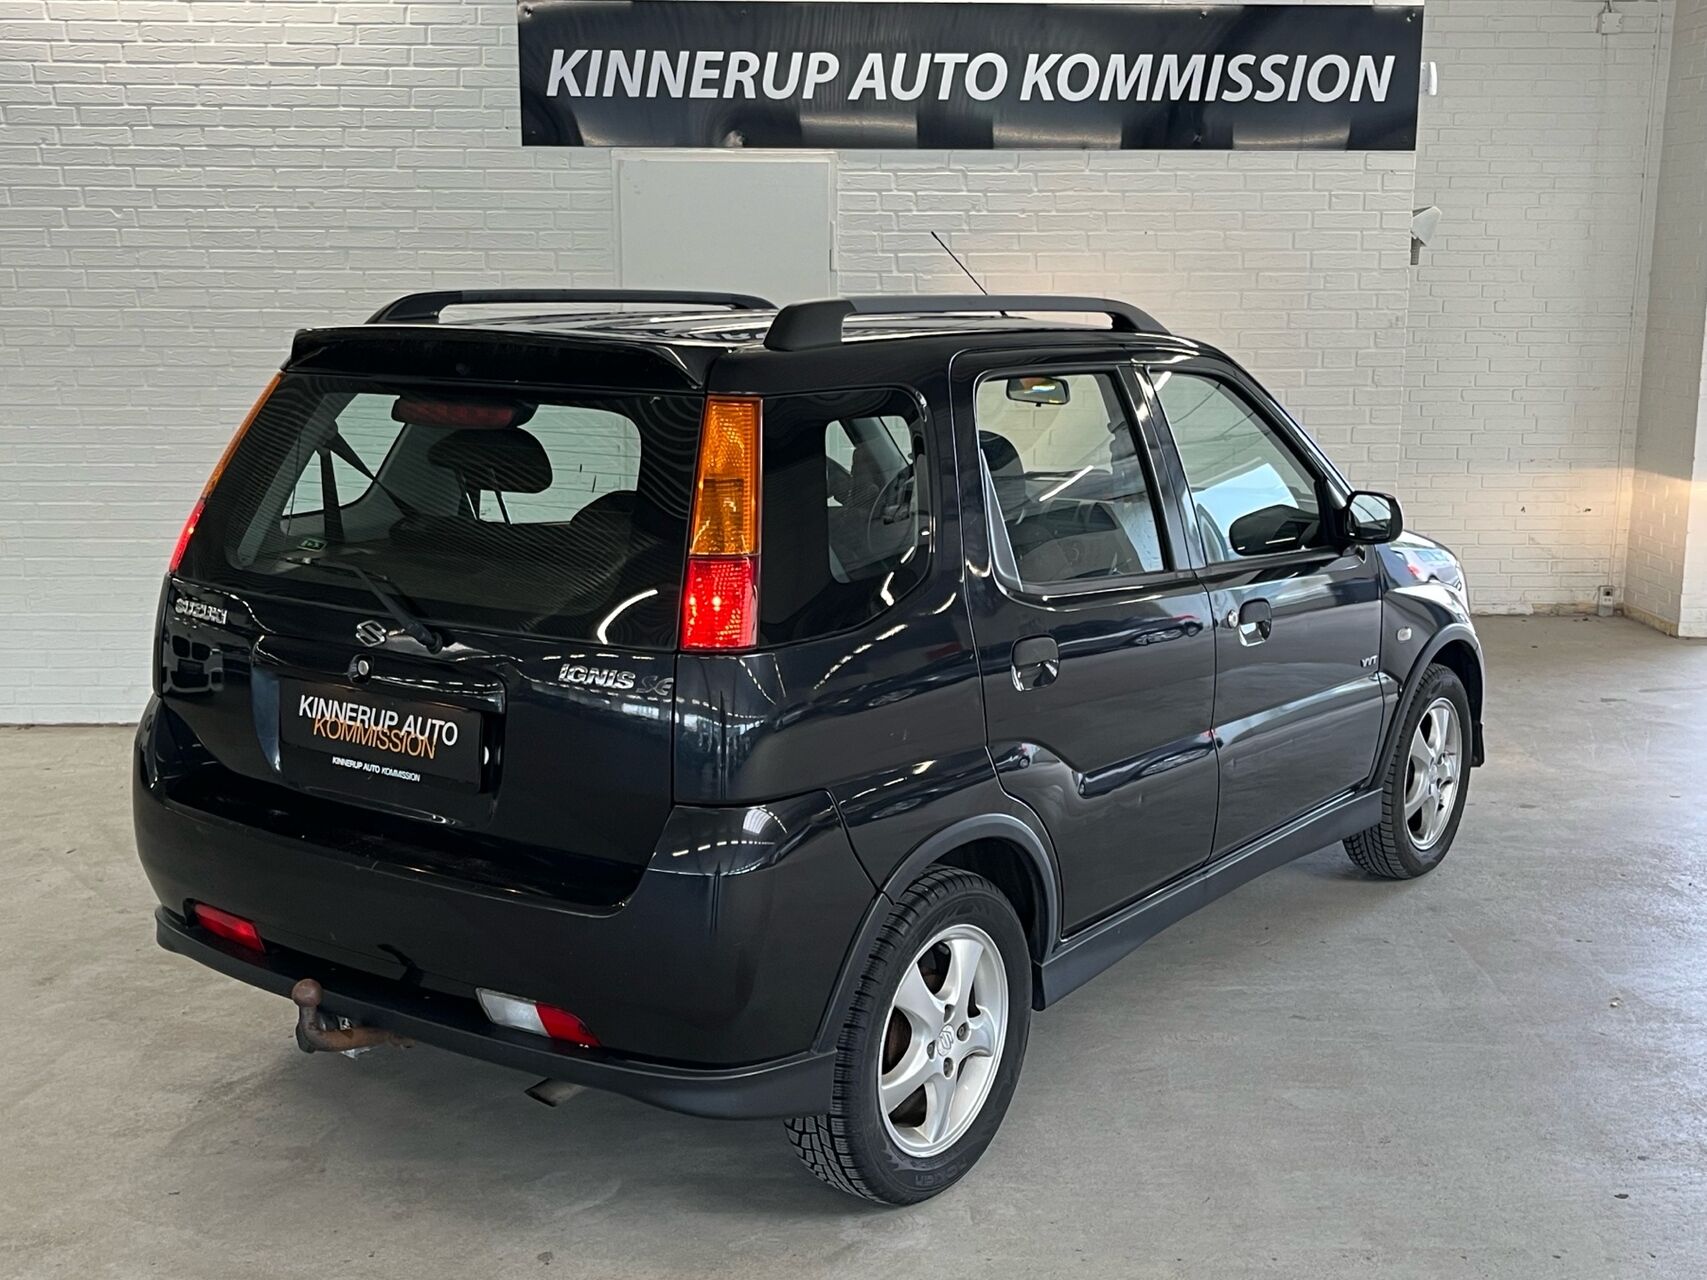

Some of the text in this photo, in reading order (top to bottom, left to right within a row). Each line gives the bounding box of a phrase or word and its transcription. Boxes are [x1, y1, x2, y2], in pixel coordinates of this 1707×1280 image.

[546, 49, 1396, 103] KINNERUP AUTO KOMMISSION
[558, 663, 636, 689] IGNIS
[299, 694, 458, 746] KINNERUP AUTO
[313, 714, 437, 760] KOMMISSION
[332, 756, 421, 782] KINNERUP AUTO KOMMISSION
